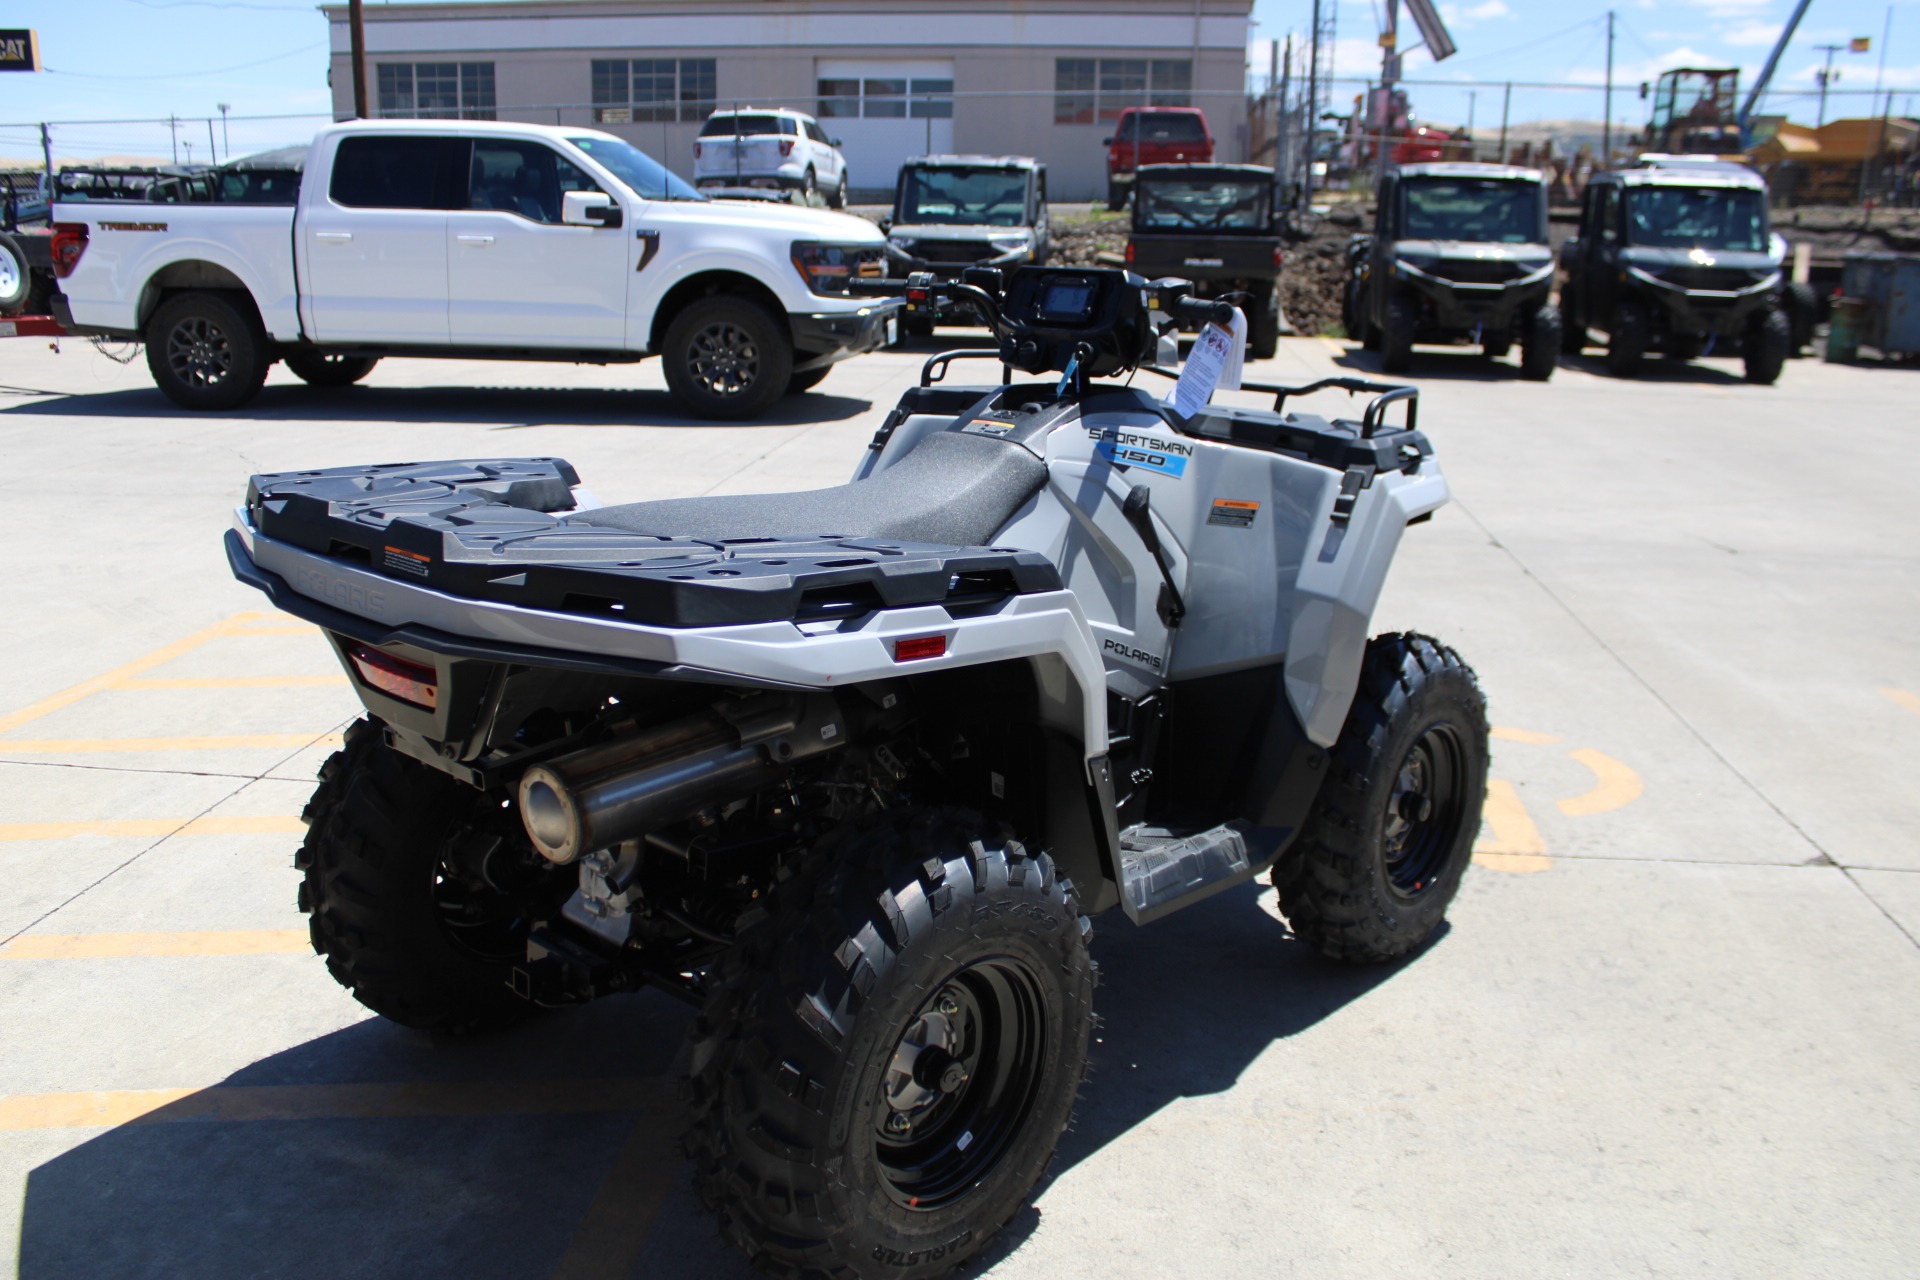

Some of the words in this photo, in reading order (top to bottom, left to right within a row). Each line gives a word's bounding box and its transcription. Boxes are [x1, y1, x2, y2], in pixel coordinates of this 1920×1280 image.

[97, 221, 168, 232] TREMOR
[1088, 428, 1193, 457] SPORTSMAN
[1110, 447, 1166, 467] 450
[296, 565, 385, 615] POLARIS
[1104, 638, 1162, 668] POLARIS
[871, 1229, 973, 1267] CARLSTAR
